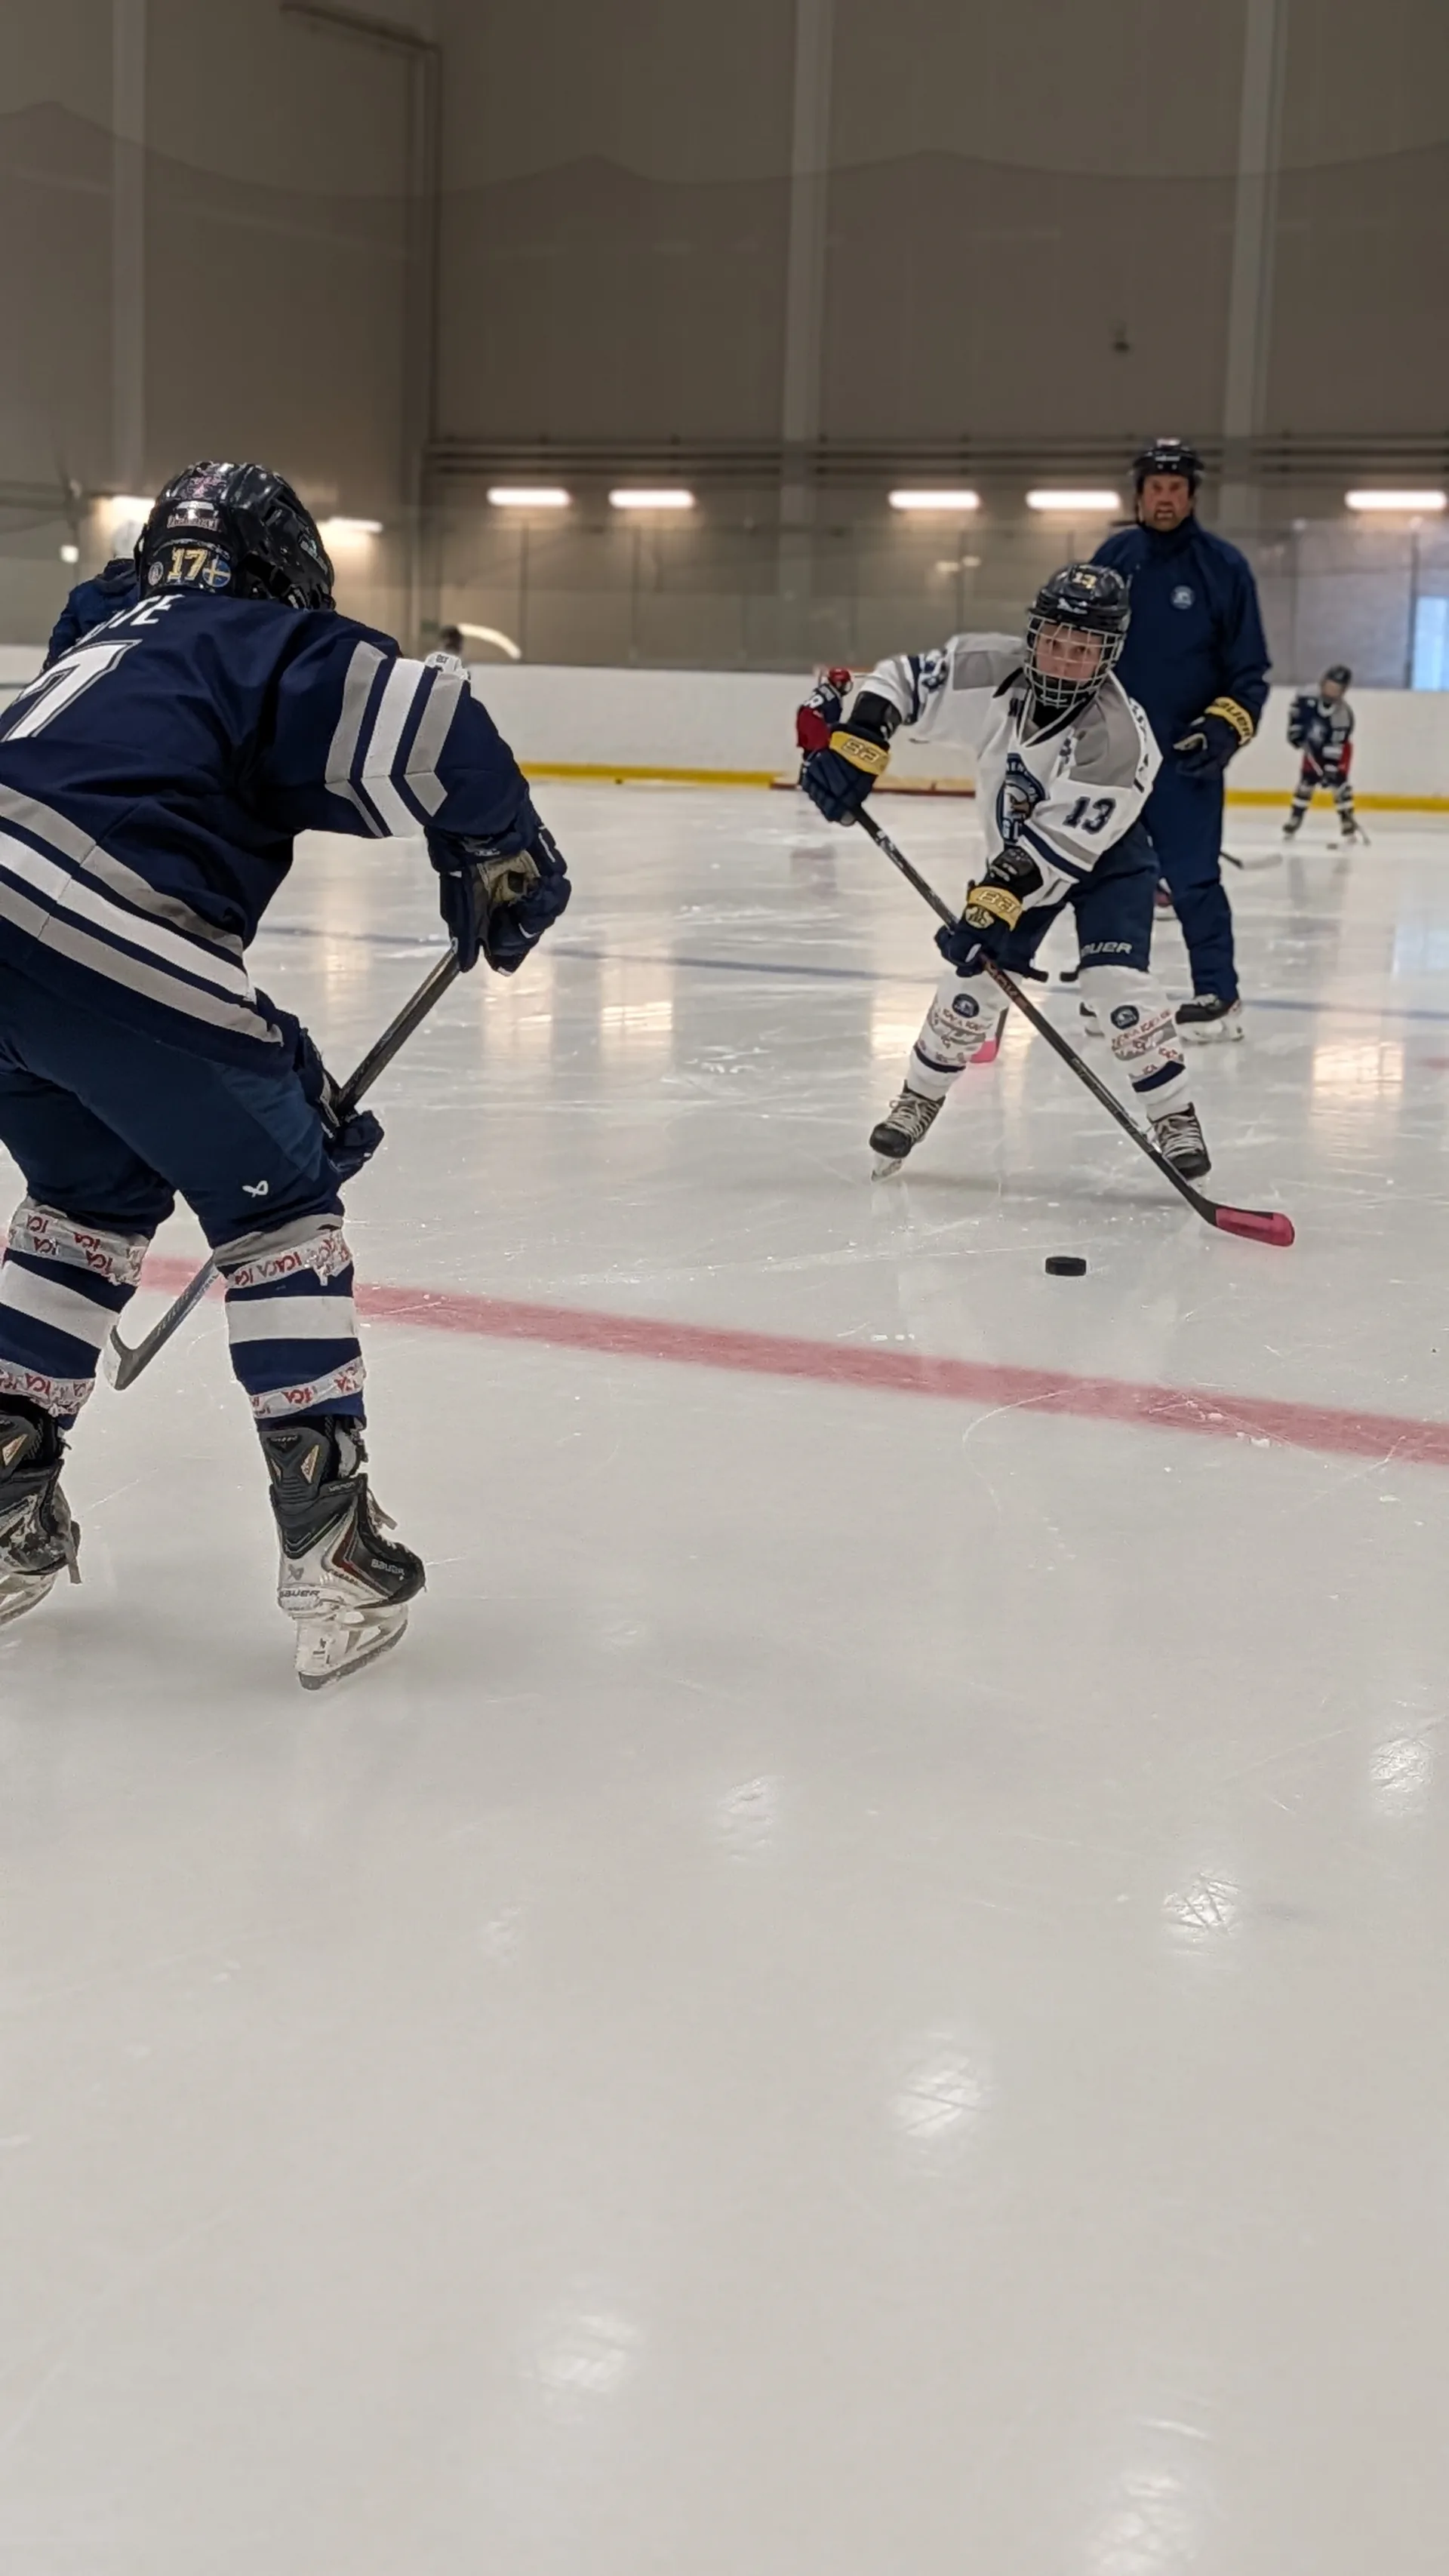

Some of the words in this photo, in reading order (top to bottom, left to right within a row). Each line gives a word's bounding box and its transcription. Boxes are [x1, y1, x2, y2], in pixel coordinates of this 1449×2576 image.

[168, 547, 208, 581] 17
[1062, 795, 1117, 835] 13
[26, 1214, 48, 1234] ICA
[85, 1250, 113, 1275] ICA
[25, 1373, 51, 1396] ICA
